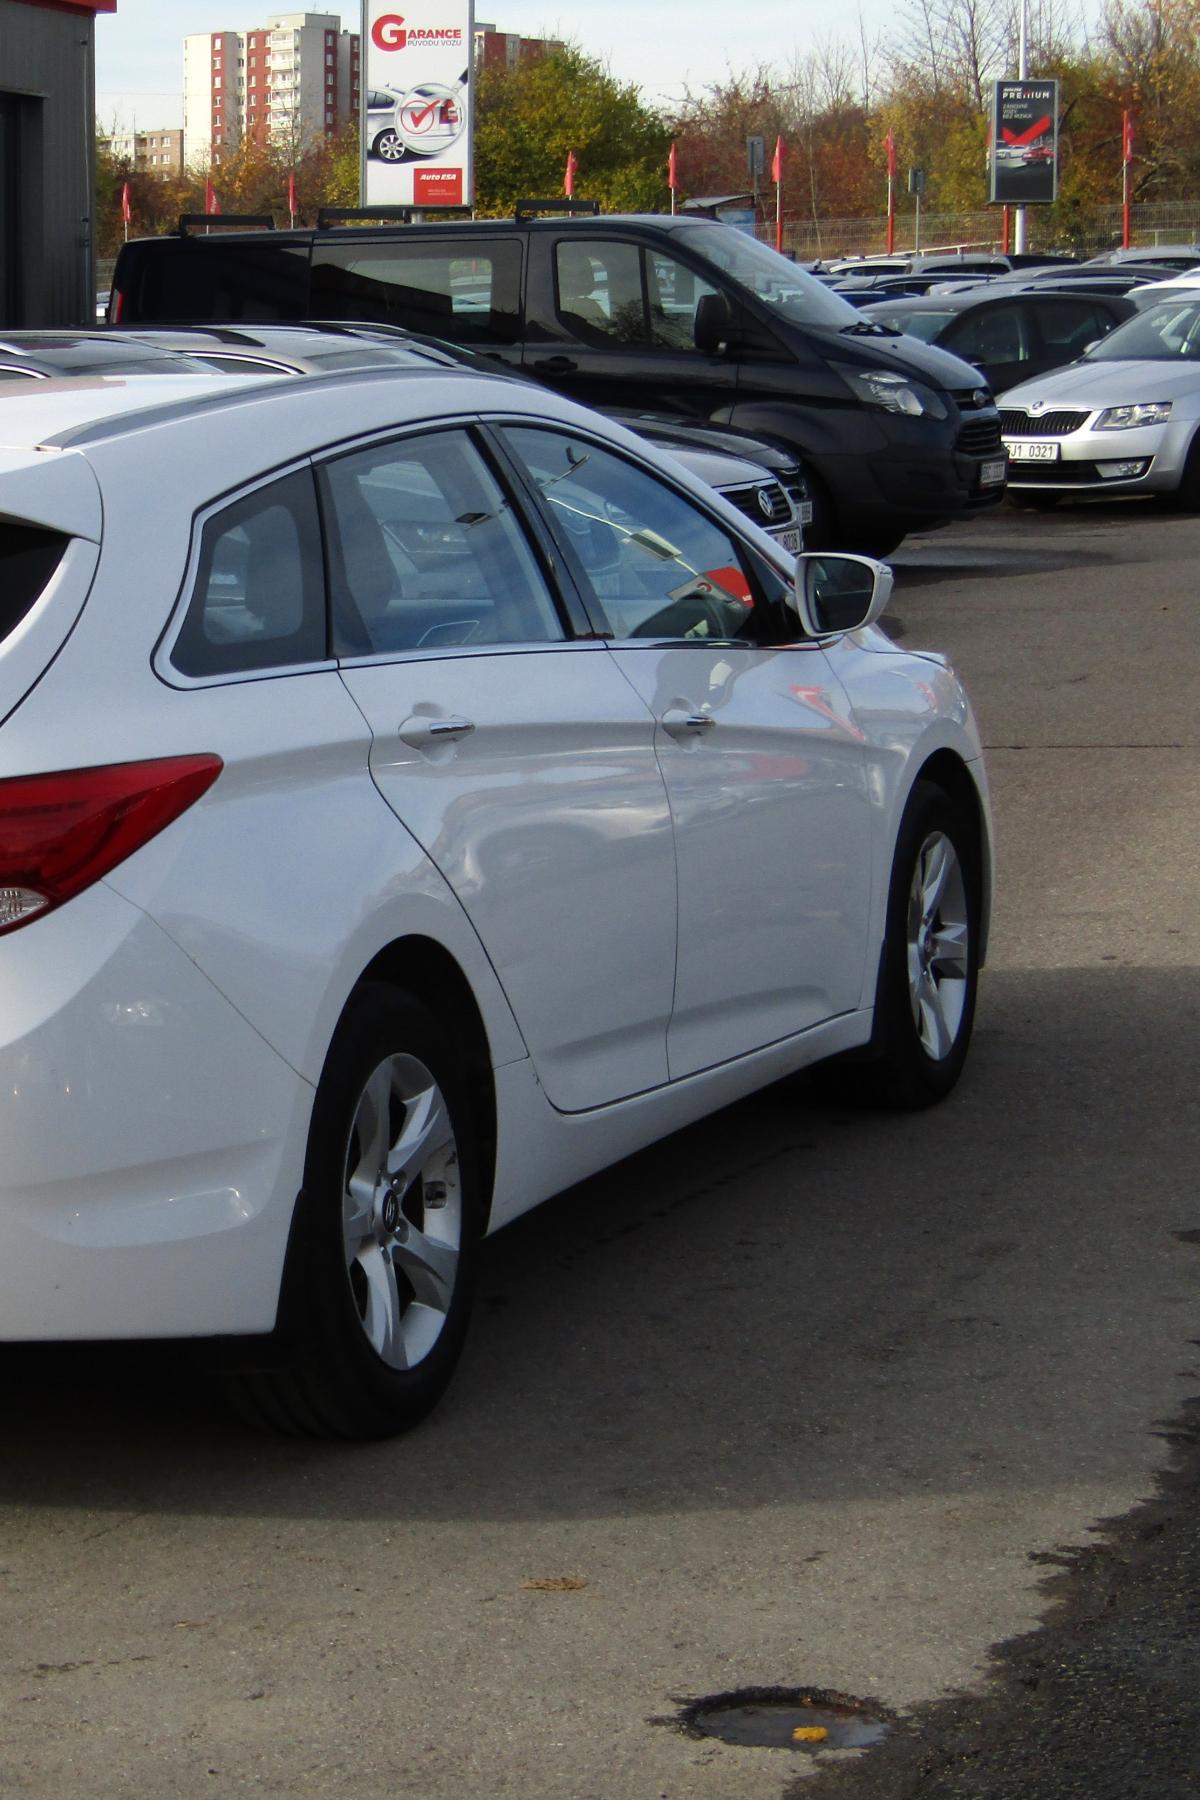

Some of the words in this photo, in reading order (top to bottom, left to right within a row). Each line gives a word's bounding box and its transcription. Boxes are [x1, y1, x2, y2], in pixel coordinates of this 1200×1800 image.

[371, 14, 461, 52] GARANCE
[1002, 91, 1049, 99] PREMIUM
[420, 173, 440, 181] Auto
[441, 173, 457, 181] ESA
[1028, 444, 1053, 458] 0321
